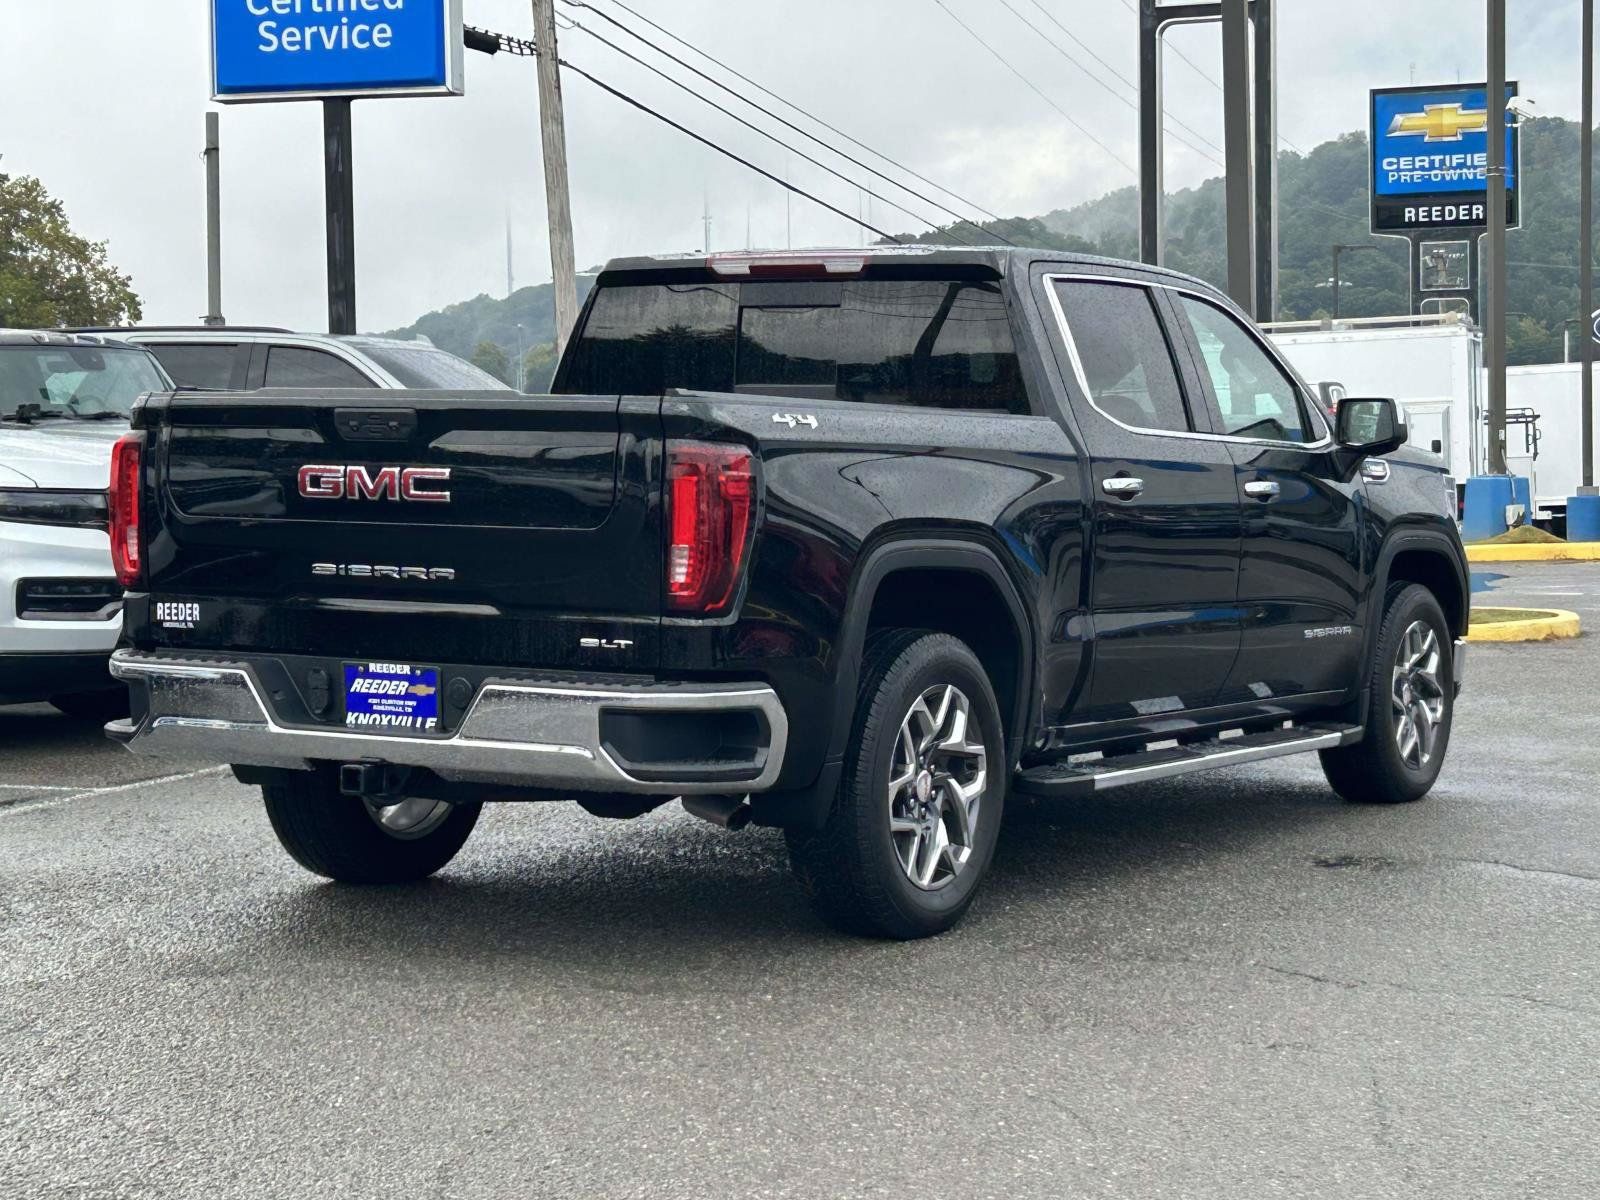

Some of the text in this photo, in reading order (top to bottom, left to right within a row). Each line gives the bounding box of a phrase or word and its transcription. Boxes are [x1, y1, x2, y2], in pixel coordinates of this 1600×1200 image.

[258, 17, 393, 52] Service
[1382, 153, 1487, 171] CERTIFIE
[1388, 168, 1487, 184] PRE-OWNE
[1404, 204, 1484, 223] REEDER
[298, 464, 451, 502] GMC
[311, 563, 456, 580] SIERRA
[156, 602, 200, 621] REEDER
[1303, 625, 1353, 640] SIERRA
[580, 637, 634, 649] SLT
[368, 662, 411, 675] REEDER
[350, 678, 410, 696] REEDER
